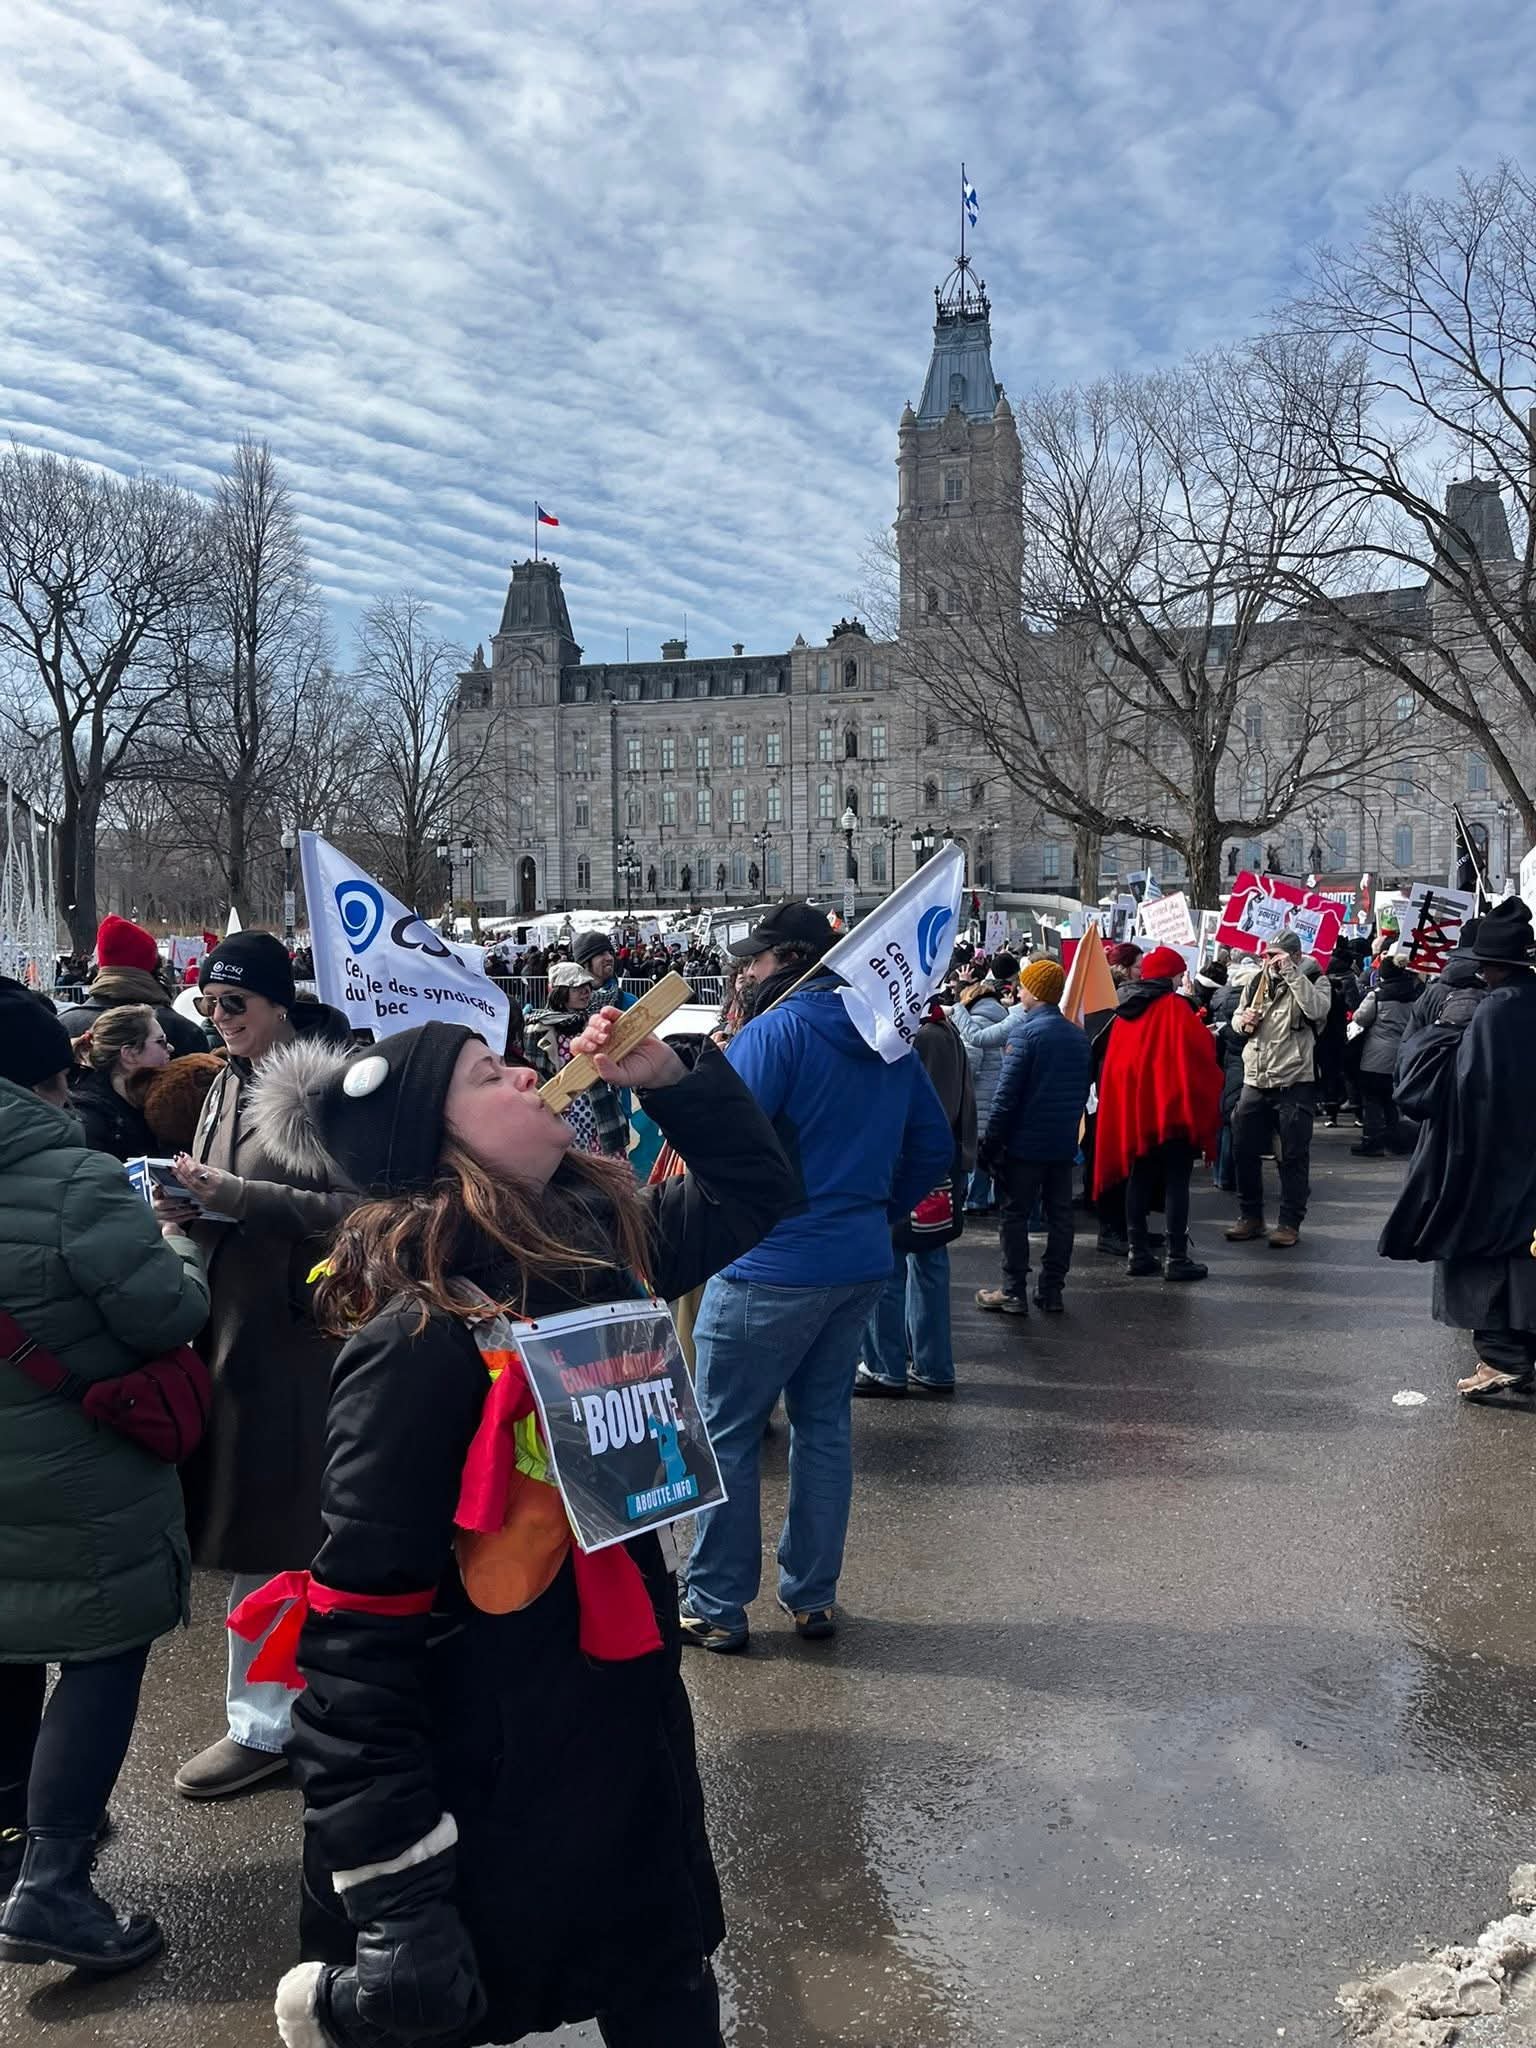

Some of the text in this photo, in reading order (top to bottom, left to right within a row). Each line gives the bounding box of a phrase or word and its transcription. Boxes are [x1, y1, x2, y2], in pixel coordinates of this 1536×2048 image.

[869, 957, 890, 979] du
[886, 942, 921, 1014] Centrale
[345, 983, 367, 1001] du
[388, 978, 419, 997] des
[423, 985, 496, 1018] syndicats
[570, 1377, 686, 1456] À BOUTTE
[635, 1479, 692, 1513] ABOUTTE.INFO
